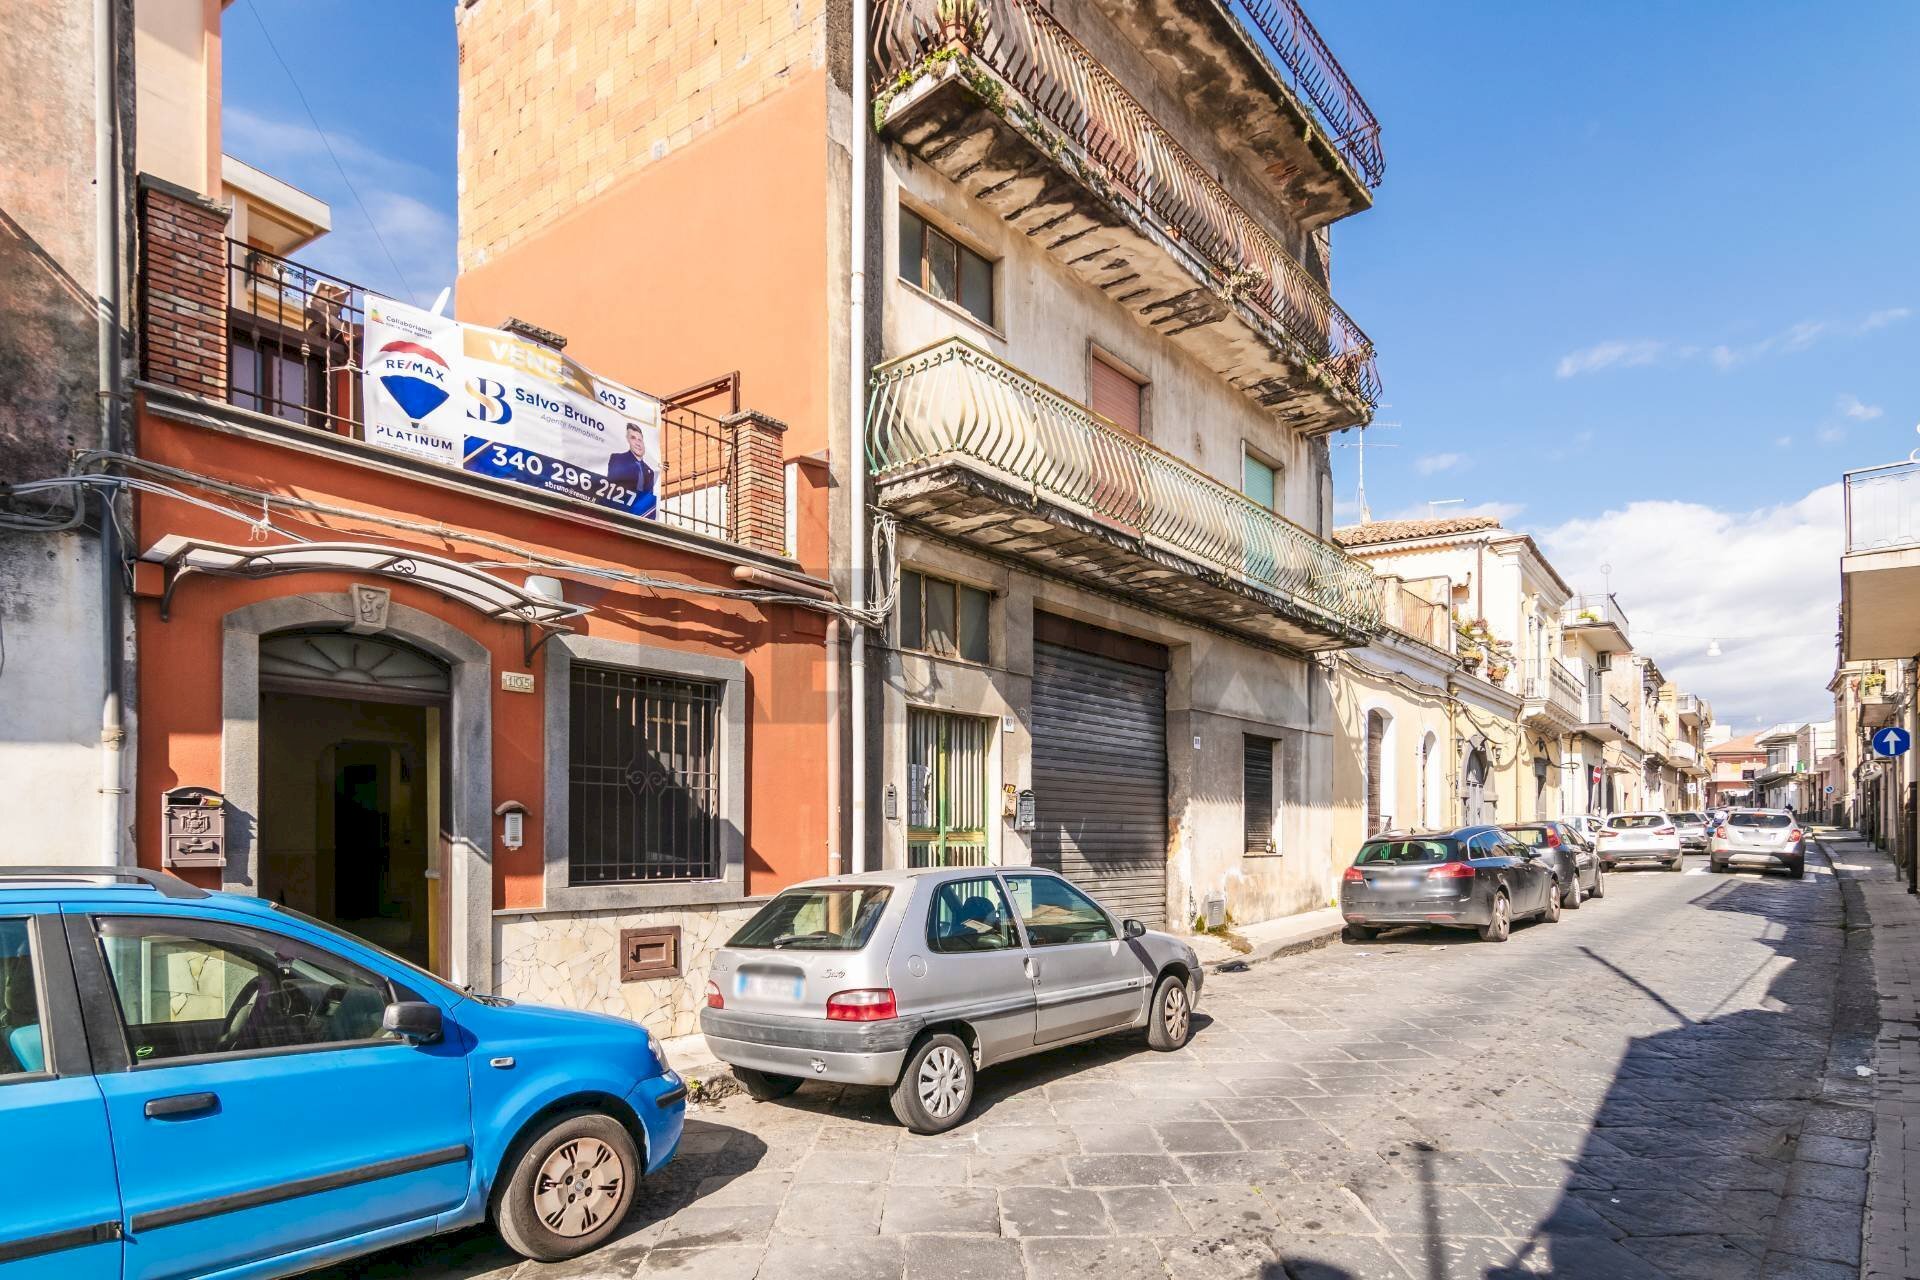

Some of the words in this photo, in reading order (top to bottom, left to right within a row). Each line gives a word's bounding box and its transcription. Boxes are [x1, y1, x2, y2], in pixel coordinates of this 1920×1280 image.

[386, 315, 432, 335] Collaboriamo
[386, 360, 444, 382] RE/MAX
[515, 387, 560, 413] Salvo
[564, 405, 605, 432] Bruno
[376, 425, 453, 450] PLATINUM
[492, 445, 543, 476] 340
[550, 462, 592, 491] 296
[595, 479, 637, 507] 2127
